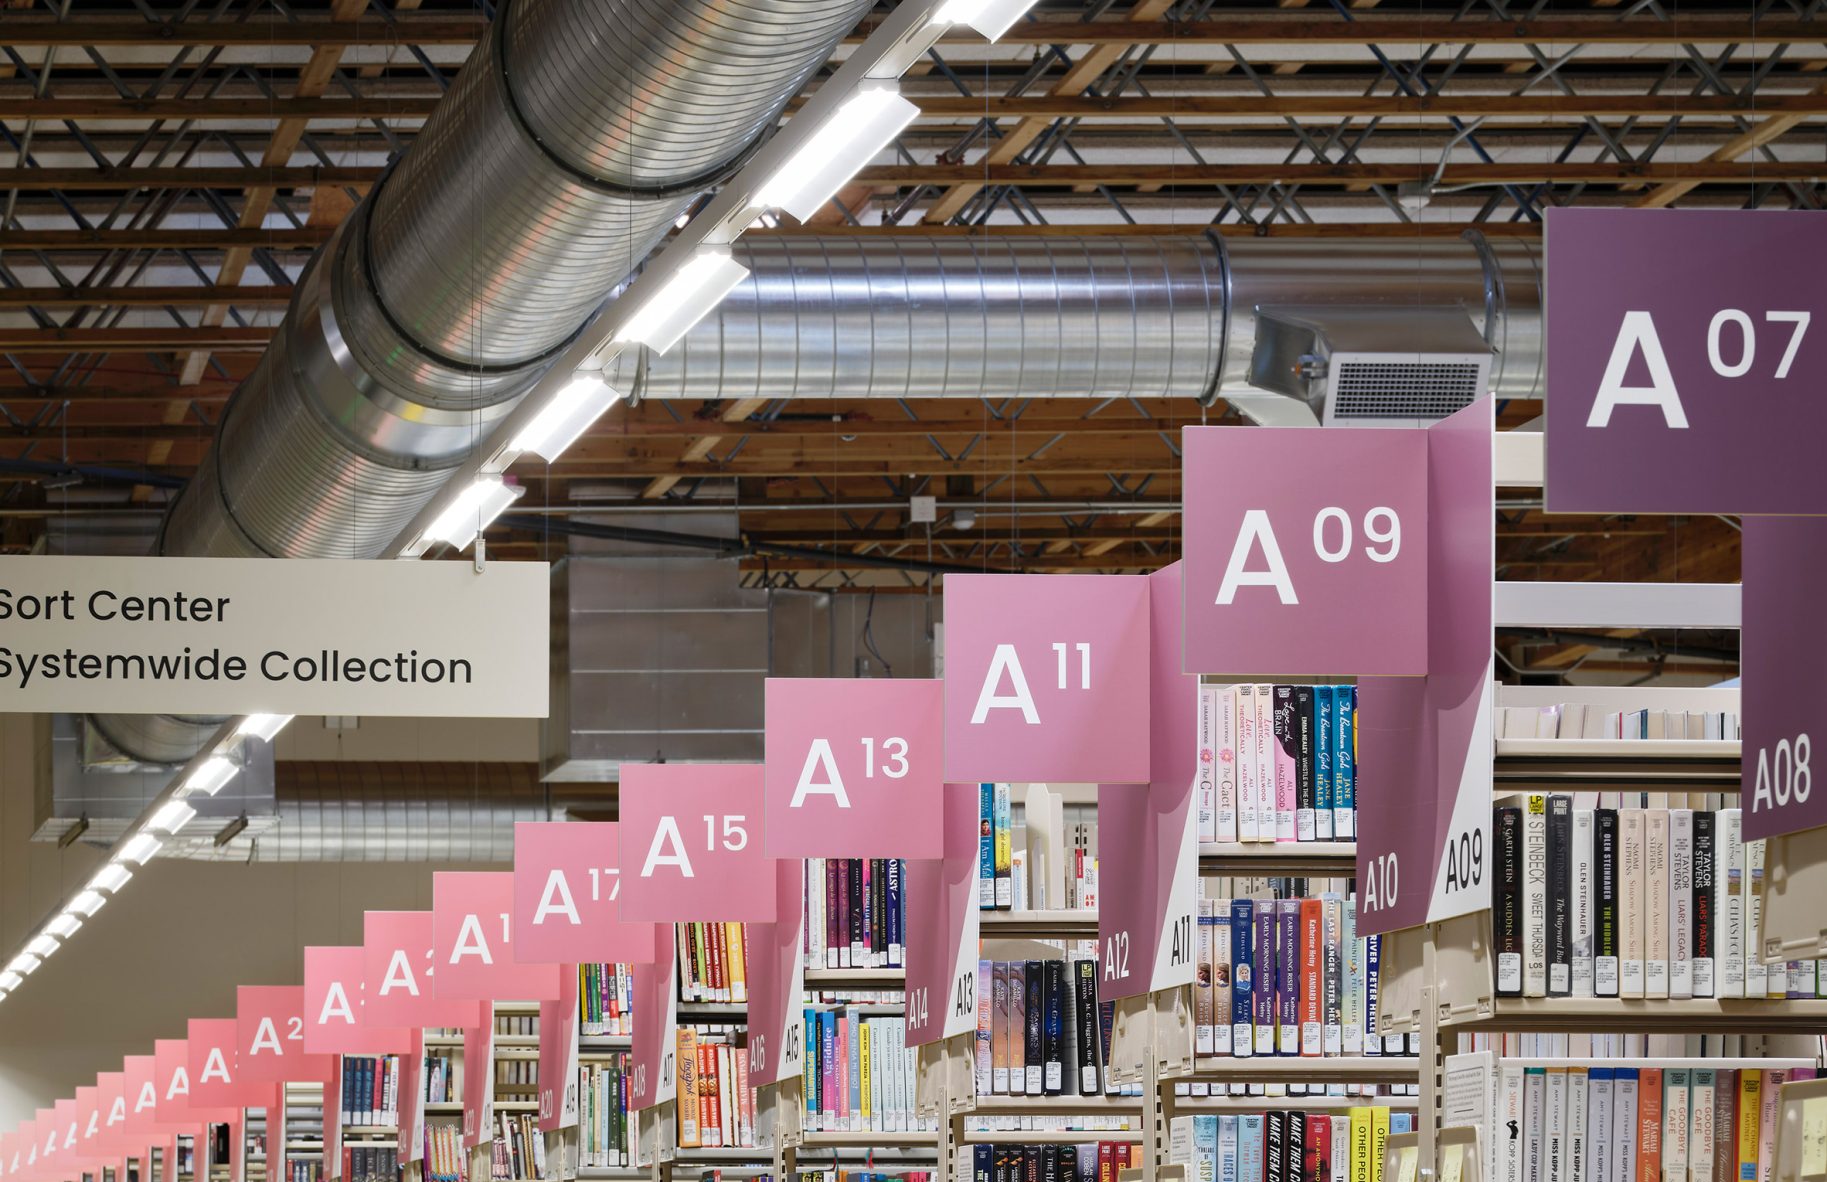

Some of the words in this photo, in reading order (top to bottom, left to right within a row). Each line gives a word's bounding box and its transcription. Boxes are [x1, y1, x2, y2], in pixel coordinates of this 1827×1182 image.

[0, 589, 74, 620] Sort
[88, 590, 230, 622] Center
[0, 647, 247, 688] Systemwide
[260, 649, 473, 684] Collection
[1752, 733, 1811, 813] A08
[1530, 795, 1542, 804] LP
[1505, 829, 1513, 856] GARTH
[1528, 822, 1544, 884] STEINBECK
[1445, 828, 1483, 894] A09
[1695, 851, 1703, 888] STEVENS
[1363, 852, 1399, 914] A10
[1532, 893, 1543, 919] SWEET
[1557, 898, 1565, 911] The
[1171, 915, 1190, 967] A11
[1555, 914, 1565, 948] Wayward
[1105, 931, 1129, 981] A12
[1557, 950, 1565, 963] Bus
[908, 987, 928, 1031] A14
[956, 971, 973, 1017] A13
[750, 1034, 765, 1073] A16
[786, 1024, 799, 1063] A15
[632, 1063, 646, 1099] A18
[663, 1052, 673, 1088] A17
[1270, 1115, 1281, 1142] MAKE
[1316, 1137, 1321, 1146] AN
[1270, 1146, 1280, 1171] THEM
